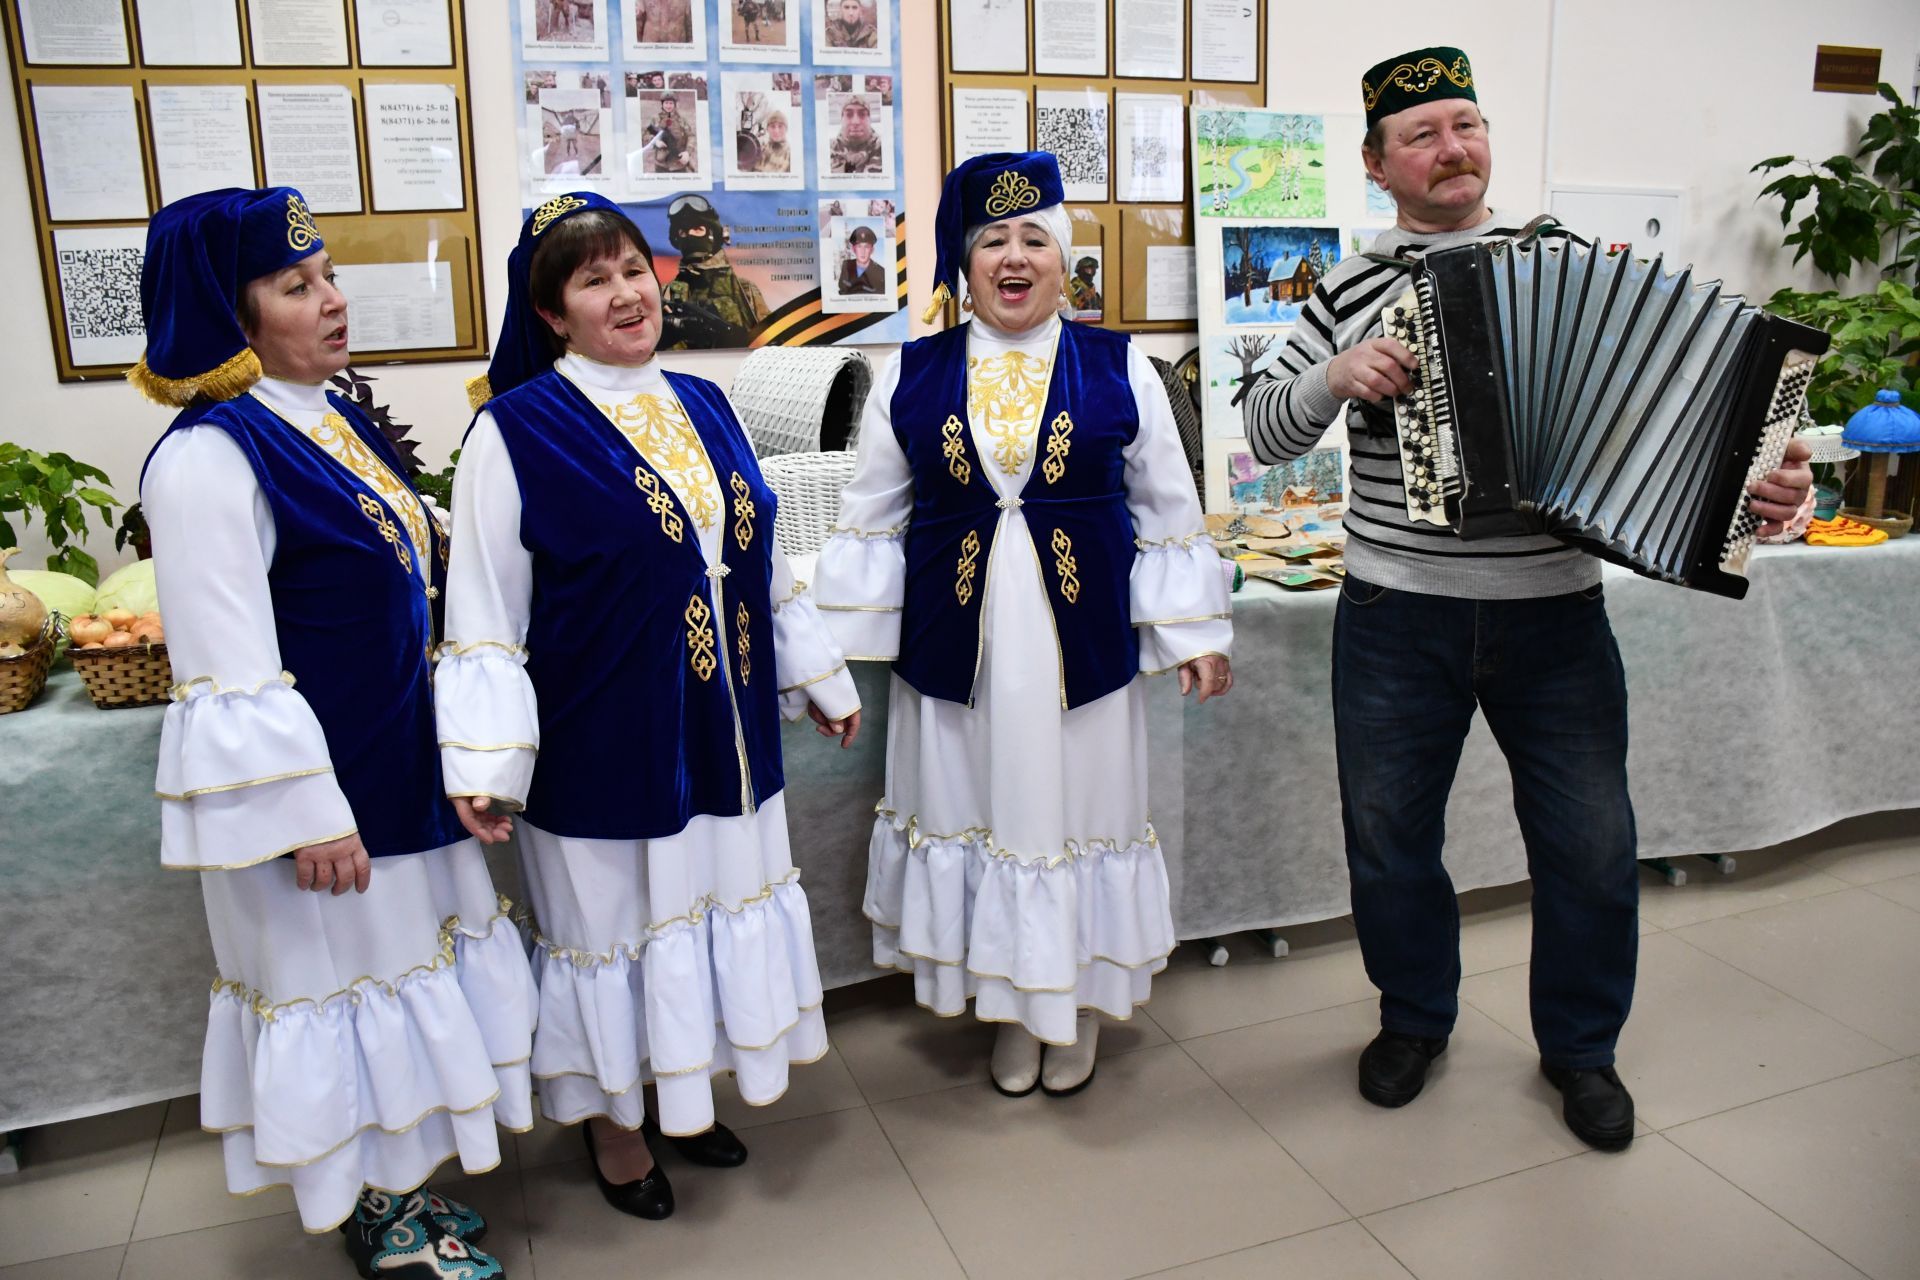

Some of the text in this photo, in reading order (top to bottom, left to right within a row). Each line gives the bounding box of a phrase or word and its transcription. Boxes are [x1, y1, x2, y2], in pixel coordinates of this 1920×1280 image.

[381, 104, 414, 113] 8(84371)
[440, 103, 449, 112] 02
[381, 117, 415, 126] 8(84371)
